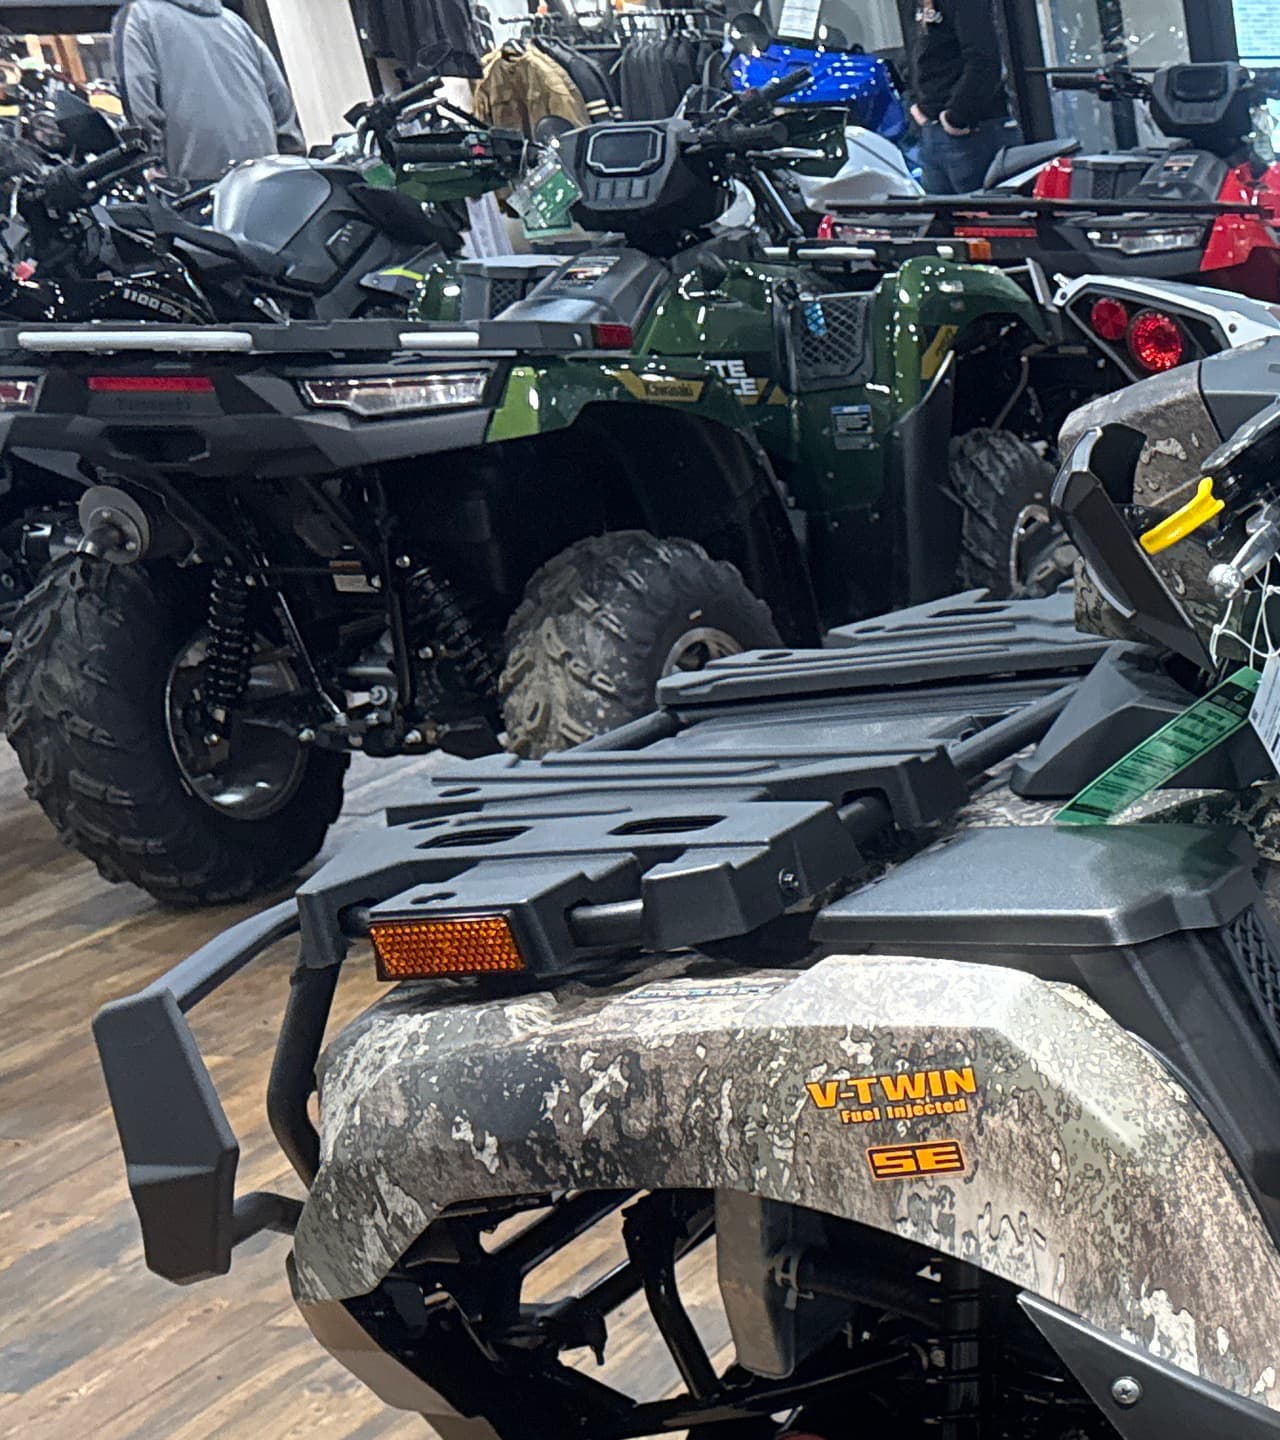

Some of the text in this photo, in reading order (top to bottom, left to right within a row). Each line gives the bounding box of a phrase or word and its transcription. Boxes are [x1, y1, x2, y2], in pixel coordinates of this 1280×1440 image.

[806, 1066, 977, 1110] V-TWIN
[841, 1098, 969, 1125] Fuel Injected
[872, 1145, 962, 1175] SE
